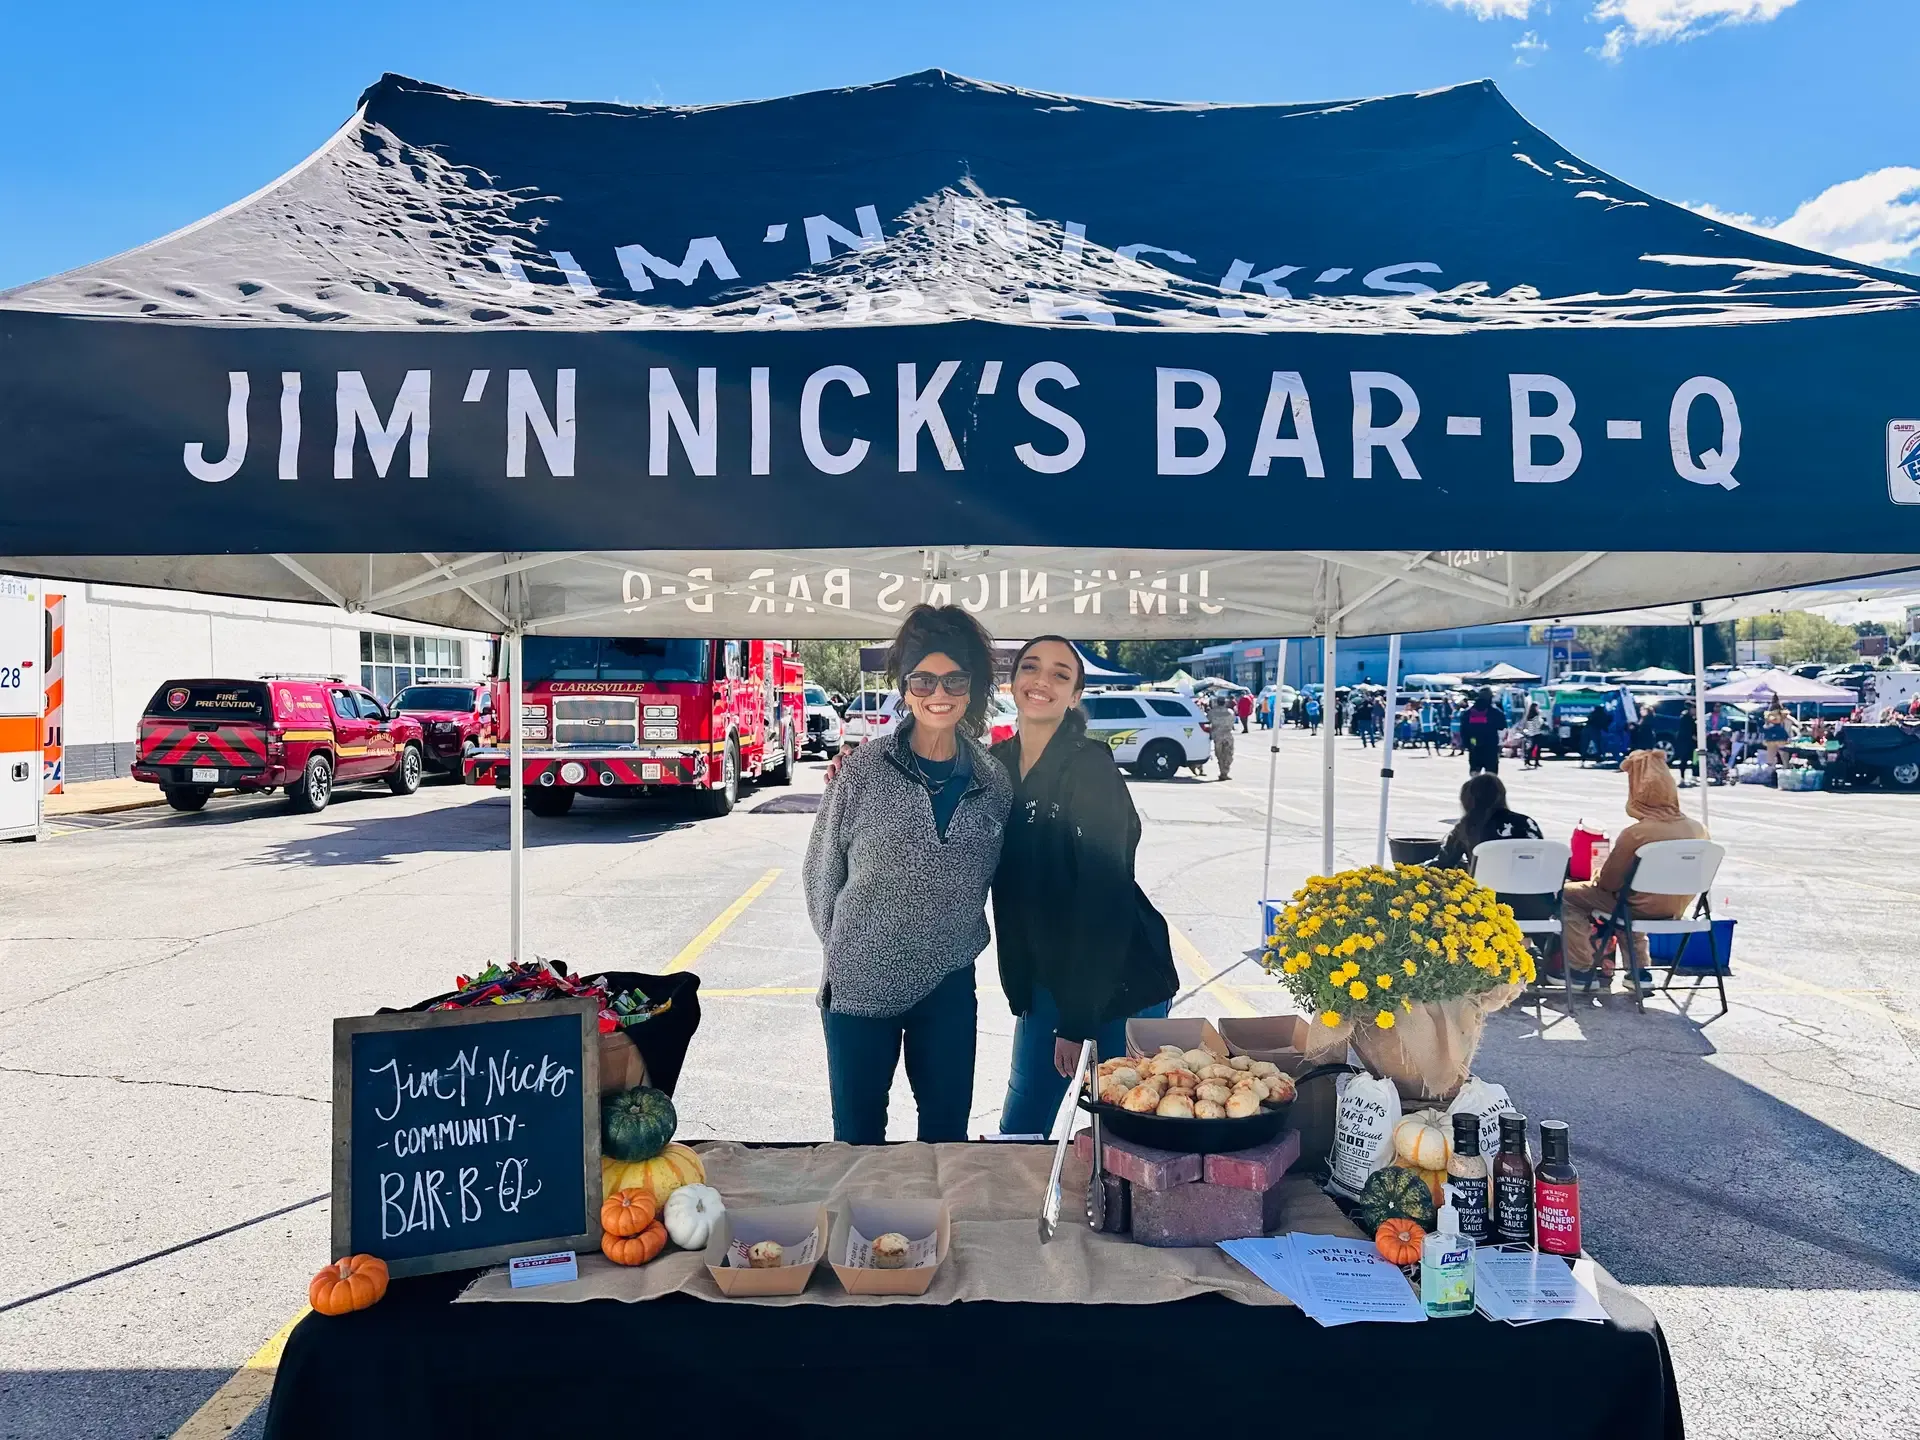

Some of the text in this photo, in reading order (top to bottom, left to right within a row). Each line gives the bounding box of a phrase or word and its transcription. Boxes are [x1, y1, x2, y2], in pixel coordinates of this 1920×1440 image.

[183, 359, 1742, 491] JIM'N NICK'S BAR-B-Q
[549, 683, 645, 692] CLARKSVILLE
[216, 693, 239, 701] FIRE
[195, 700, 256, 708] PREVENTION
[1350, 1122, 1383, 1142] Biscuit
[1481, 1121, 1500, 1137] BAR-
[1338, 1131, 1365, 1149] MIX
[1501, 1184, 1526, 1194] BAR-B-Q
[380, 1158, 526, 1240] BAR-B-Q
[1498, 1200, 1529, 1214] Original
[1542, 1205, 1569, 1217] HONEY
[1461, 1214, 1483, 1224] White
[1500, 1211, 1528, 1221] BAR-B-Q
[1538, 1210, 1576, 1224] HABANERO
[1463, 1223, 1482, 1231] SAUCE
[1503, 1219, 1524, 1228] SAUCE
[1540, 1219, 1573, 1232] BAR-B-Q
[1323, 1255, 1375, 1265] BAR-B-Q
[1443, 1252, 1466, 1263] Purell
